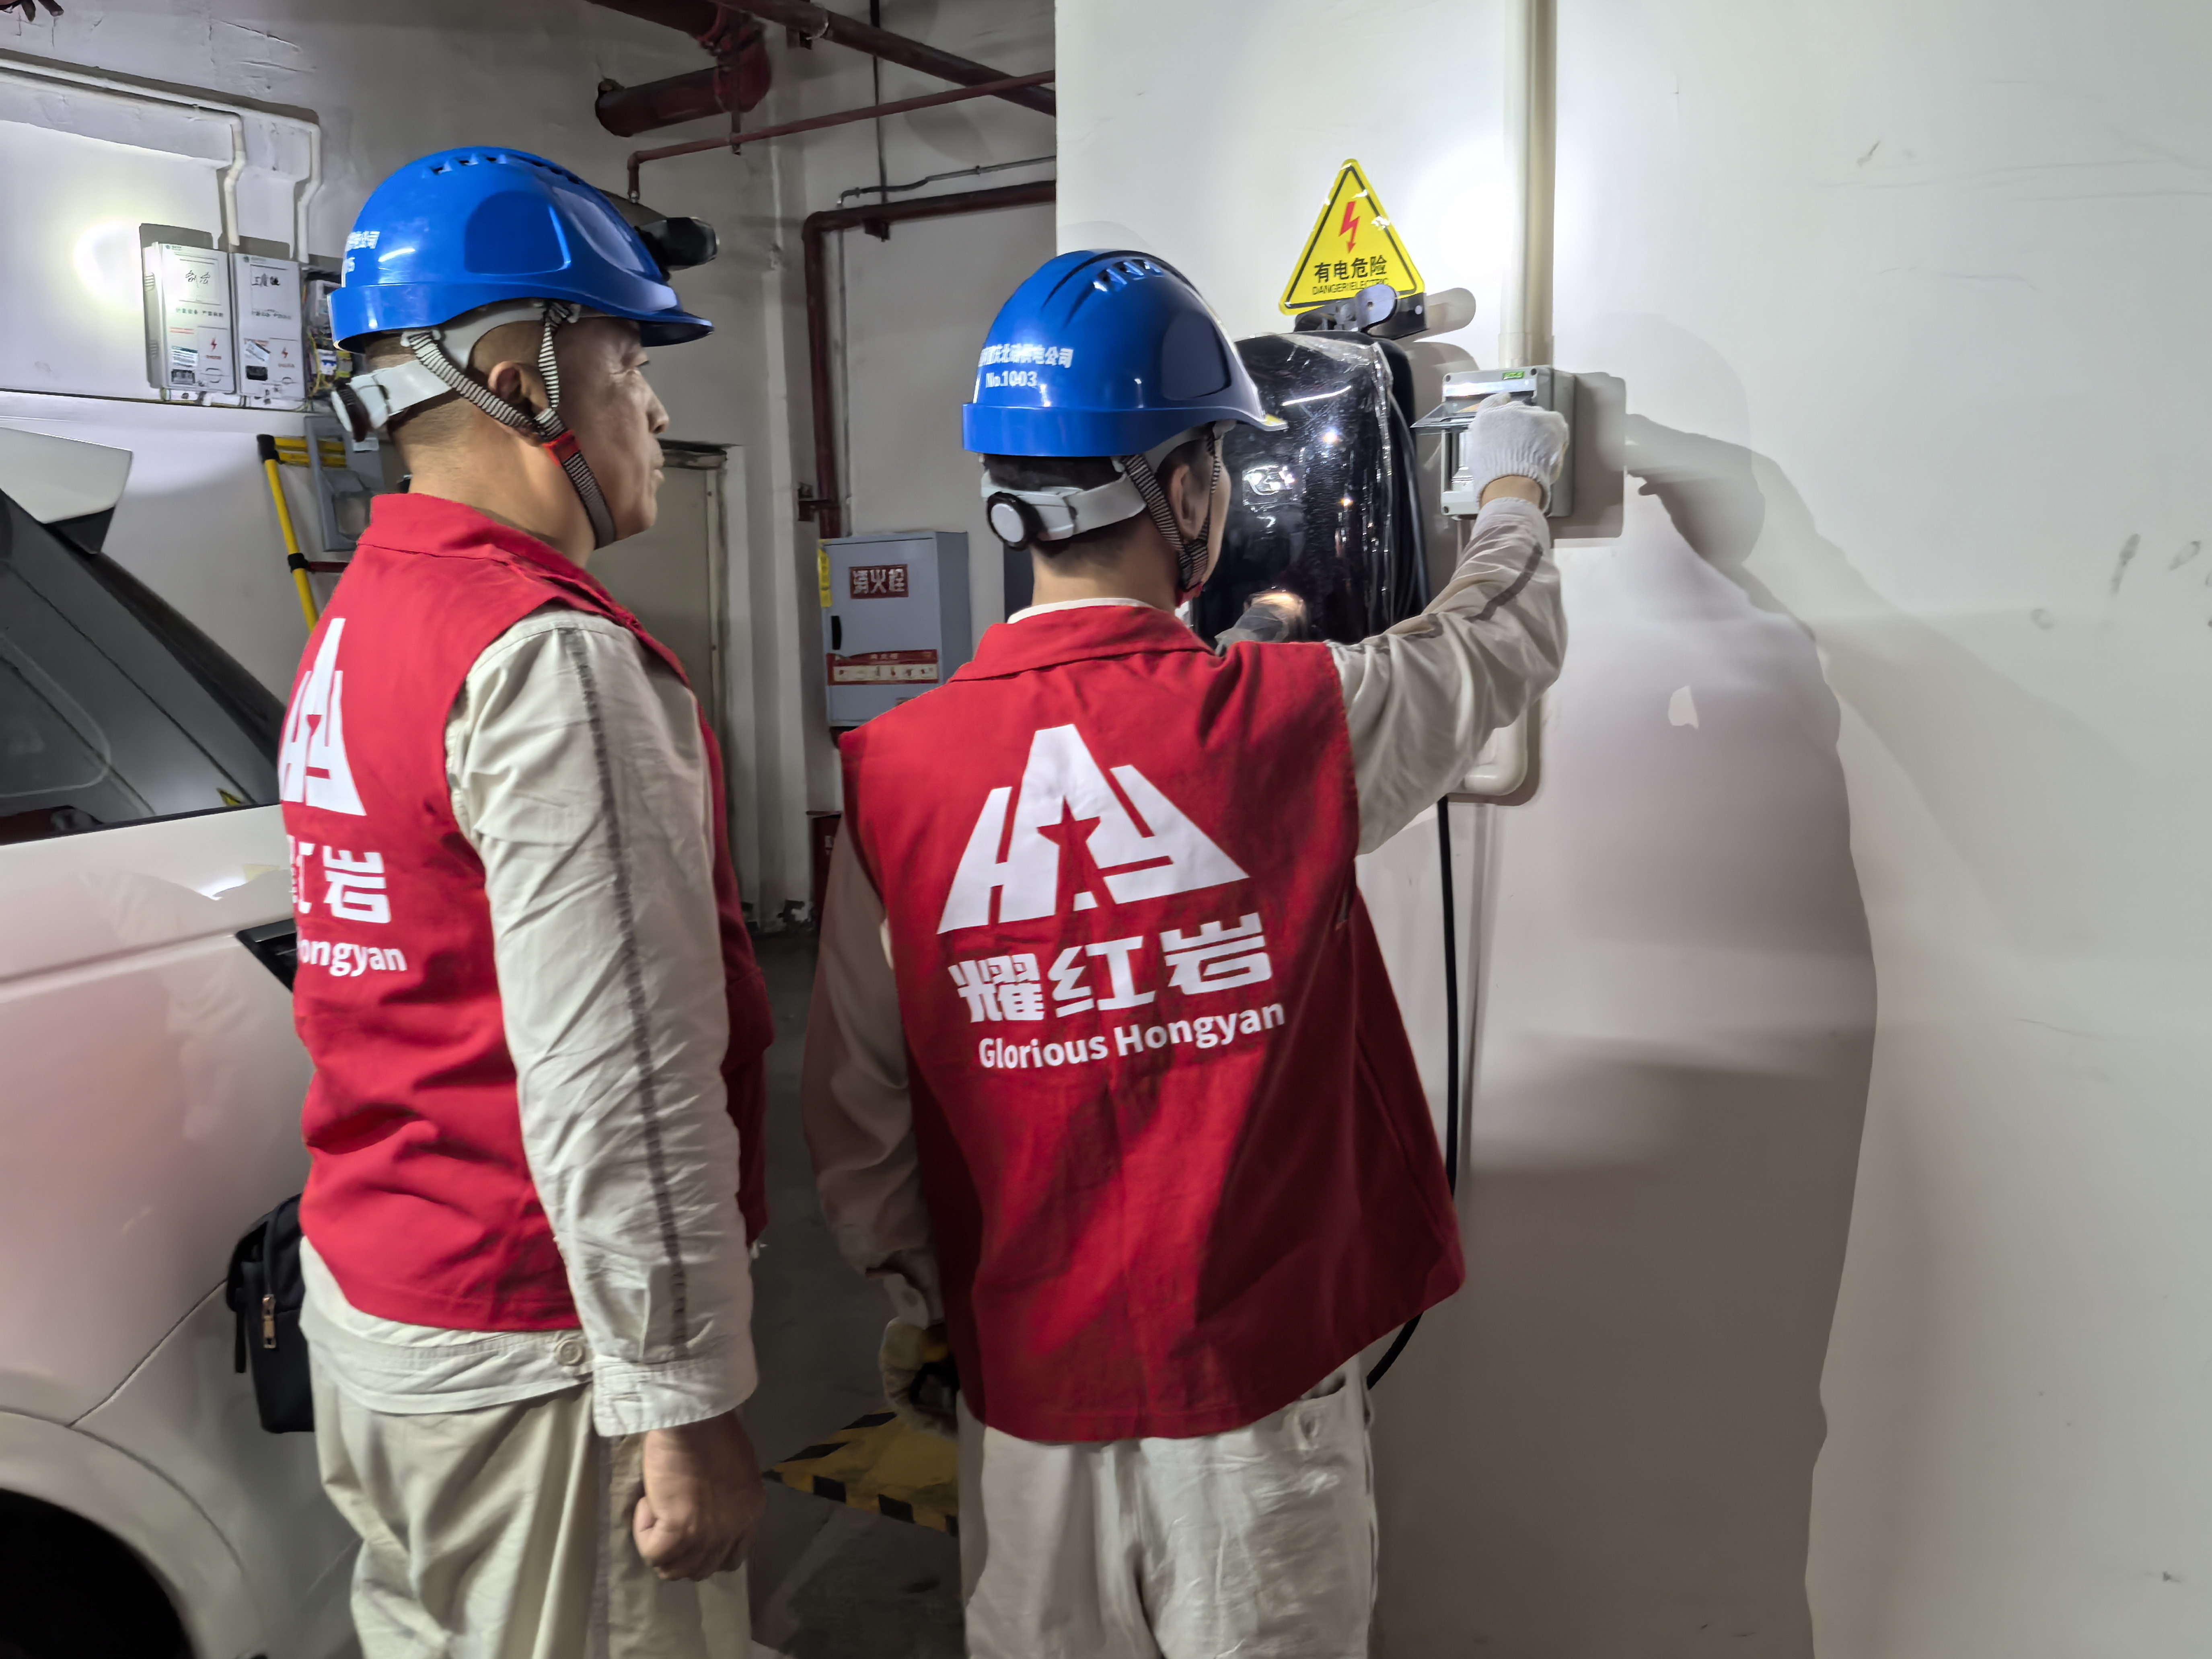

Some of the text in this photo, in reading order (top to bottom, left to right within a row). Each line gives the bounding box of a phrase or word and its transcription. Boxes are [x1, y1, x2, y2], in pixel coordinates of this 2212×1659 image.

[1314, 254, 1388, 283] 有电危险
[298, 938, 408, 977] ongyan
[948, 912, 1273, 1023] 耀红岩
[979, 1003, 1285, 1069] Glorious Hongyan
